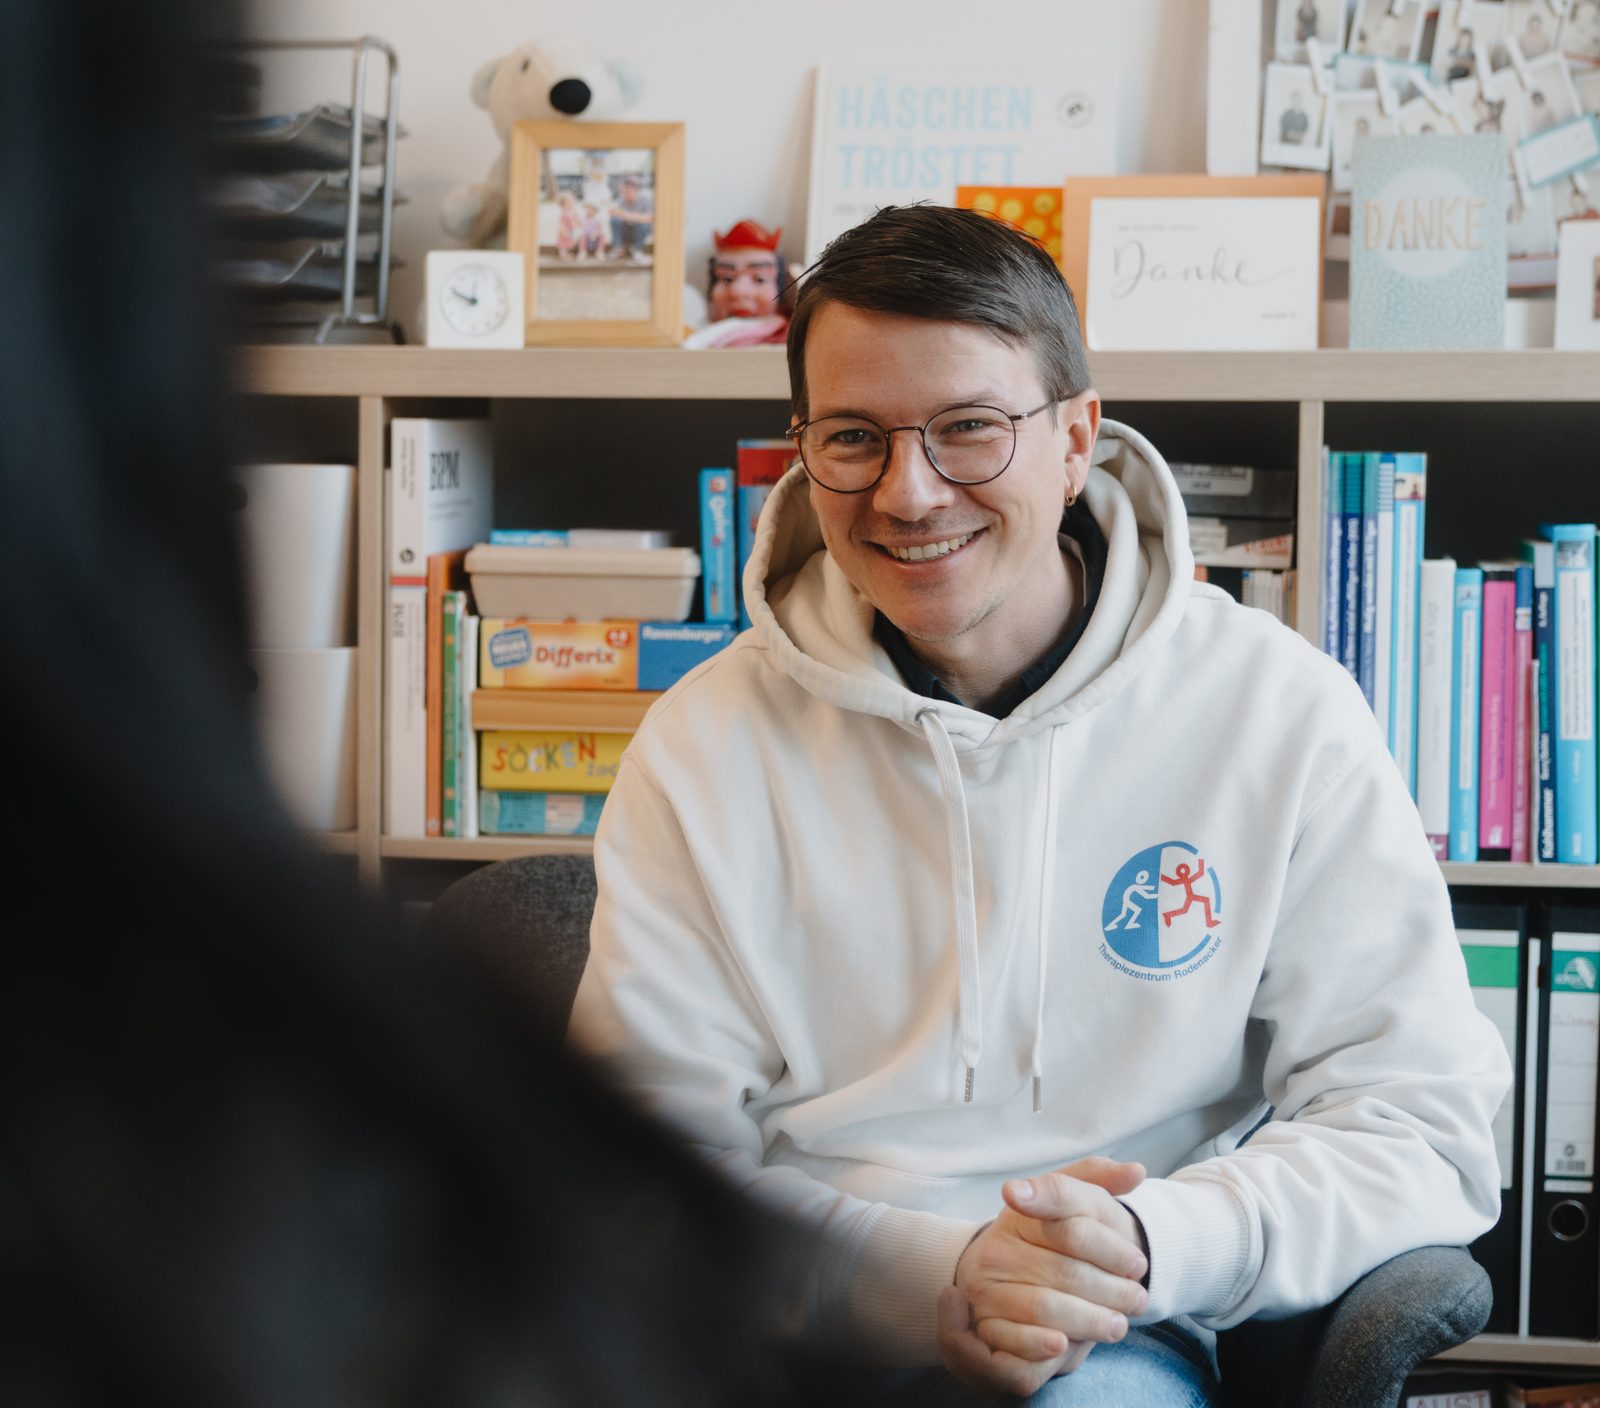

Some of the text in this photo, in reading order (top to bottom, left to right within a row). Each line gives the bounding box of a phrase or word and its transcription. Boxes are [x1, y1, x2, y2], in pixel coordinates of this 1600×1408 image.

[838, 75, 1034, 130] HÄSCHEN
[836, 137, 1022, 190] TRÖSTET
[1363, 195, 1487, 252] DANKE
[1110, 240, 1294, 299] Danke
[535, 646, 616, 668] Differix
[642, 626, 723, 643] Ravensburger
[1098, 936, 1222, 982] Therapiezentrum Rodenacker
